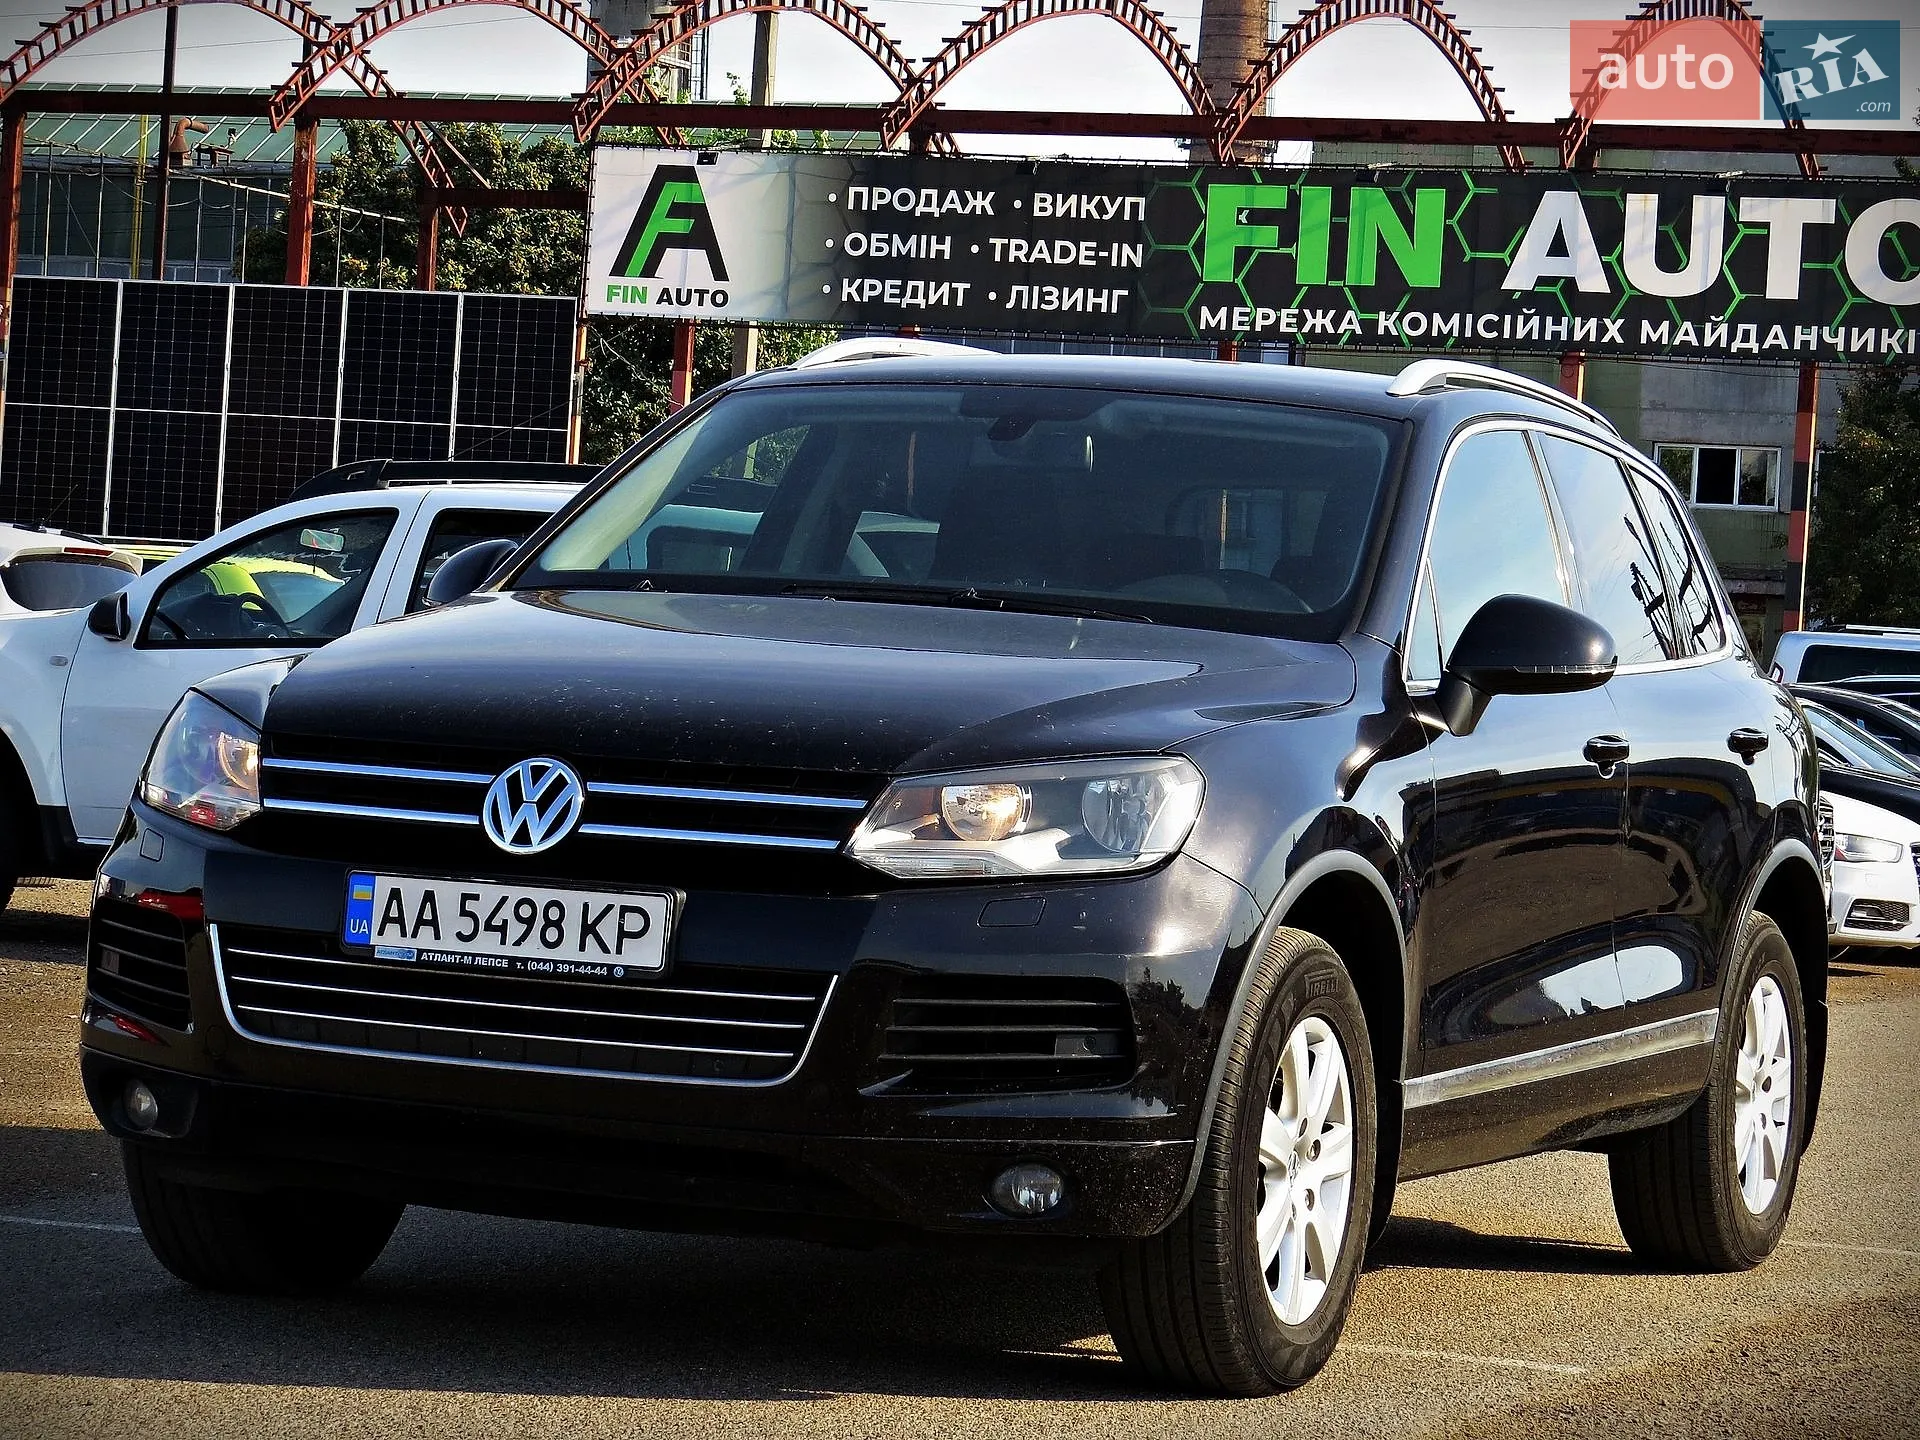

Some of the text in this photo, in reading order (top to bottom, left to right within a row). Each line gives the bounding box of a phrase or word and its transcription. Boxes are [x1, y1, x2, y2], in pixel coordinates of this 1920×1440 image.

[847, 186, 1146, 222] ПРОДАЖ ВИКУП
[843, 232, 1143, 267] ОБМІН TRADE-IN
[1202, 183, 1920, 305] FIN AUTO
[606, 285, 729, 308] FIN AUTO
[841, 279, 1128, 313] КРЕДИТ ЛІЗИНГ
[1199, 306, 1362, 334] МЕРЕЖА
[1379, 306, 1625, 344] КОМІСІЙНИХ
[350, 918, 368, 934] UA
[377, 888, 651, 955] AA 5498 KP
[421, 953, 472, 965] АТЛАНТ-М
[474, 957, 508, 967] ЛЕПСЕ
[527, 960, 553, 972] (044)
[556, 963, 607, 975] 391-44-44
[1304, 968, 1339, 998] PIRELLI
